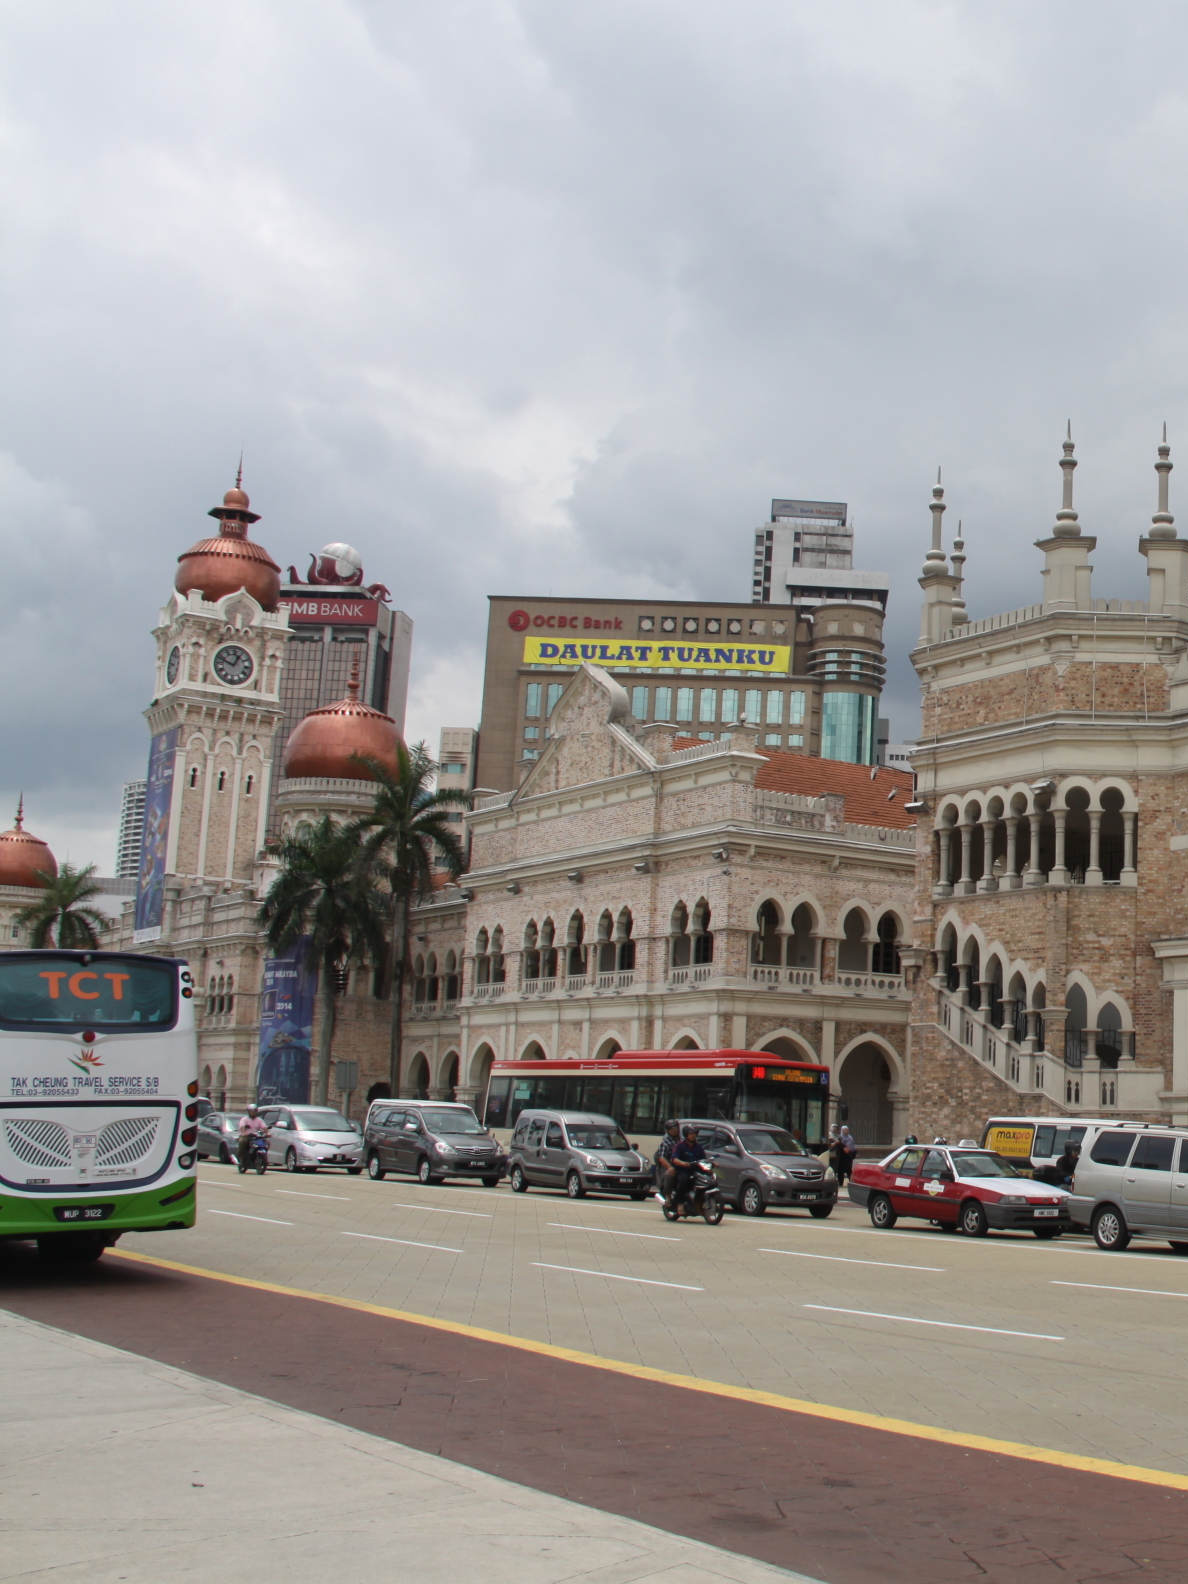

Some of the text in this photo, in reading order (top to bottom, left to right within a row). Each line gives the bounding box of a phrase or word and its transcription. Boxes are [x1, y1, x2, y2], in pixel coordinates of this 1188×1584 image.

[320, 603, 364, 617] BANK
[533, 614, 623, 630] OCBC Bank
[539, 642, 776, 666] DAULAT TUANKU
[38, 971, 131, 1000] TCT
[276, 1002, 293, 1010] 2014
[11, 1076, 160, 1088] TAK CHEUNG TRAVEL SERVICE S/B
[996, 1130, 1031, 1142] maxpro
[64, 1209, 102, 1219] WUP 3122
